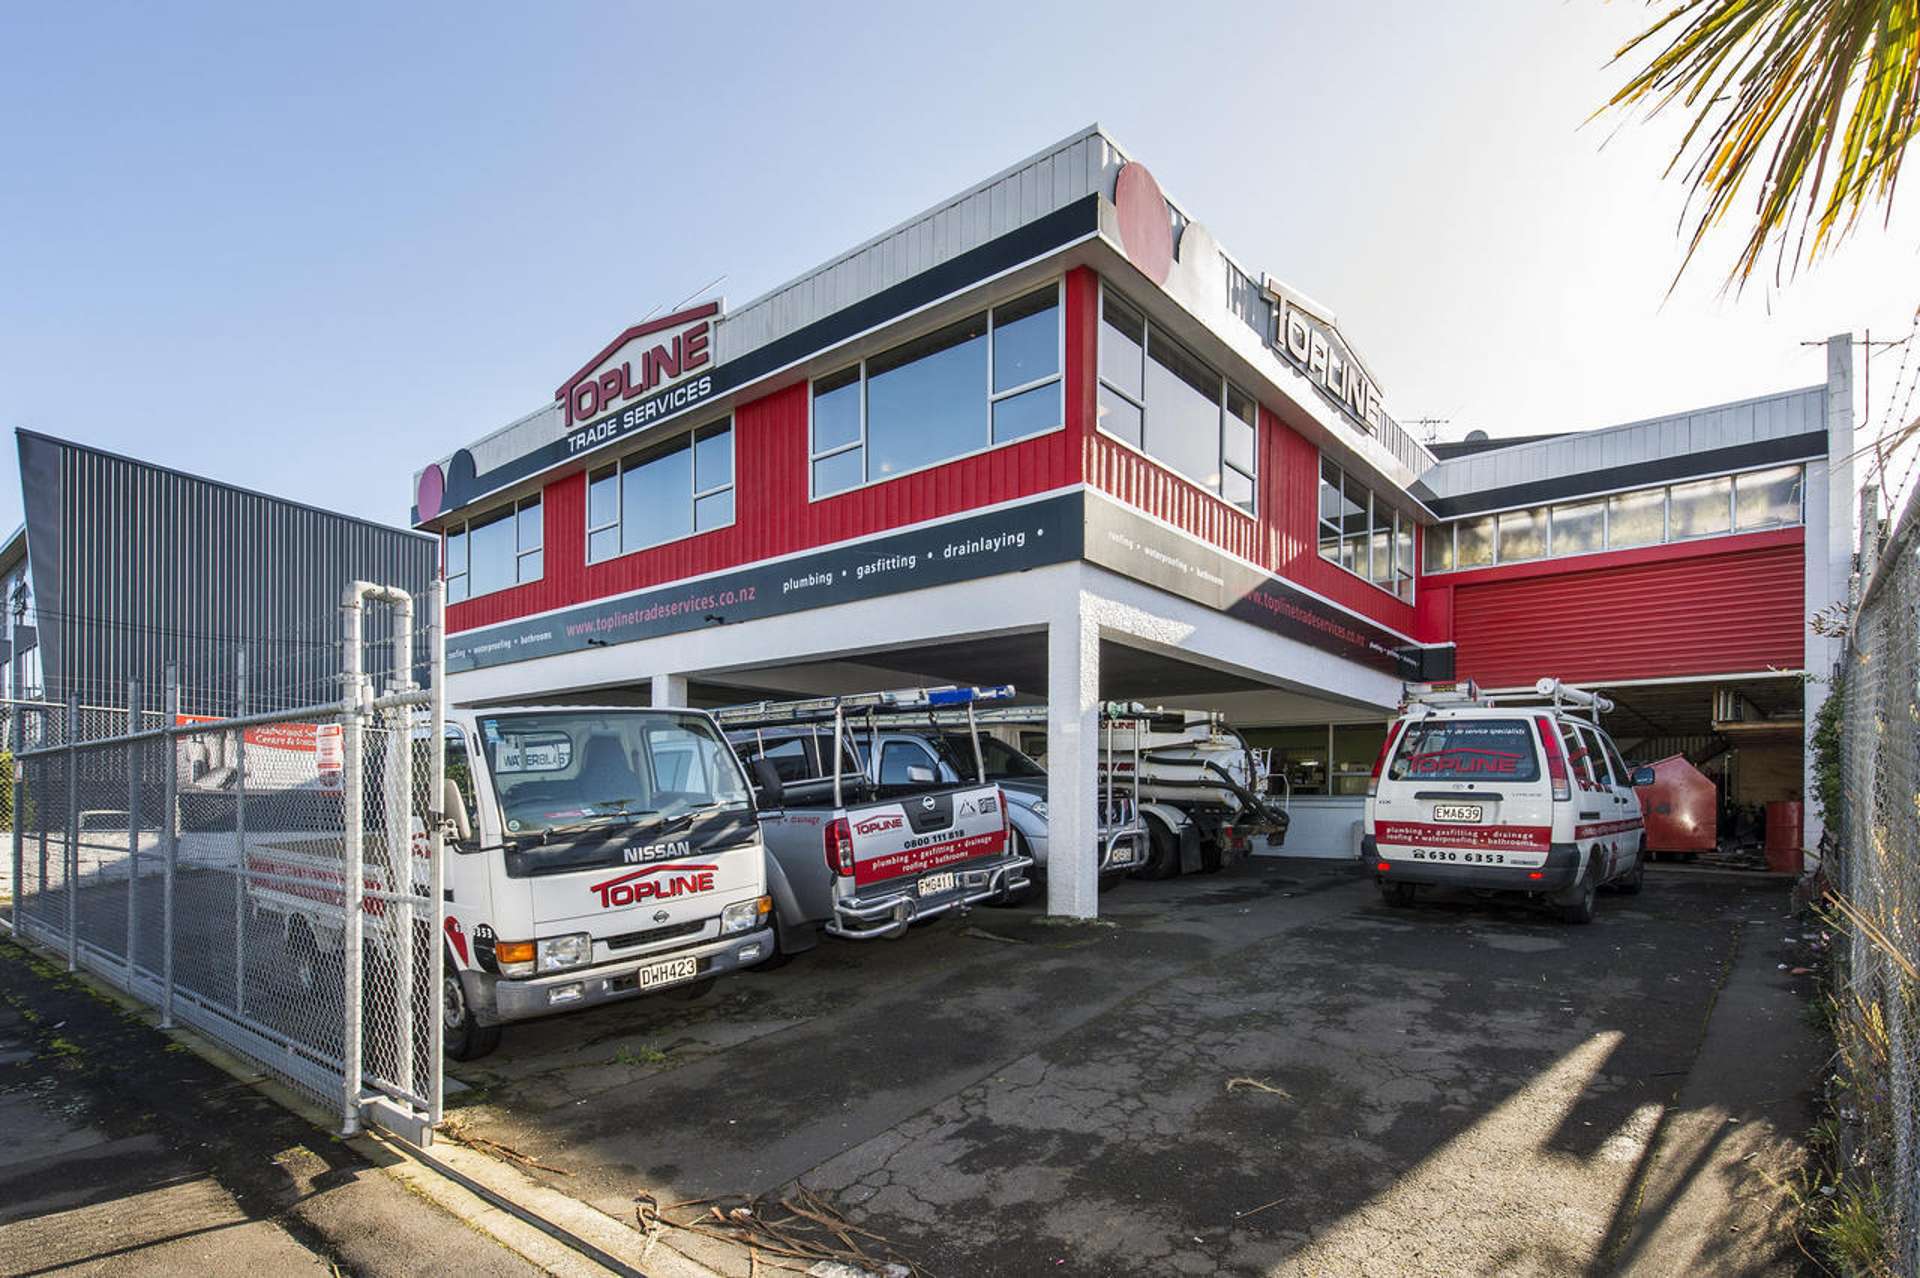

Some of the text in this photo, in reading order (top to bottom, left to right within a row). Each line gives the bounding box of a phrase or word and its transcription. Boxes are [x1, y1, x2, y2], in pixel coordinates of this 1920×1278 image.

[555, 303, 715, 428] TOPLINE
[1268, 278, 1381, 440] TOPLINE
[568, 376, 712, 452] TRADE SERVICES
[783, 530, 1026, 593] plumbing gasfitting drainlaying
[565, 585, 756, 638] www.toplinetradeservices.co.nz
[1407, 749, 1520, 773] TOPLINE
[854, 815, 904, 835] TOPLINE
[1436, 807, 1480, 819] EMA639
[904, 837, 930, 849] 0800
[1386, 827, 1534, 839] plumbing gasfitting drainage
[1386, 833, 1412, 842] roofing
[1421, 834, 1478, 845] waterproofing
[623, 841, 690, 863] NISSAN
[872, 836, 992, 870] plumbing gasfitting drainage
[902, 850, 969, 872] roofing bathrooms
[1429, 850, 1456, 861] 630
[1464, 852, 1504, 864] 6353
[591, 866, 717, 907] TOPLINE
[641, 960, 695, 986] DWH423
